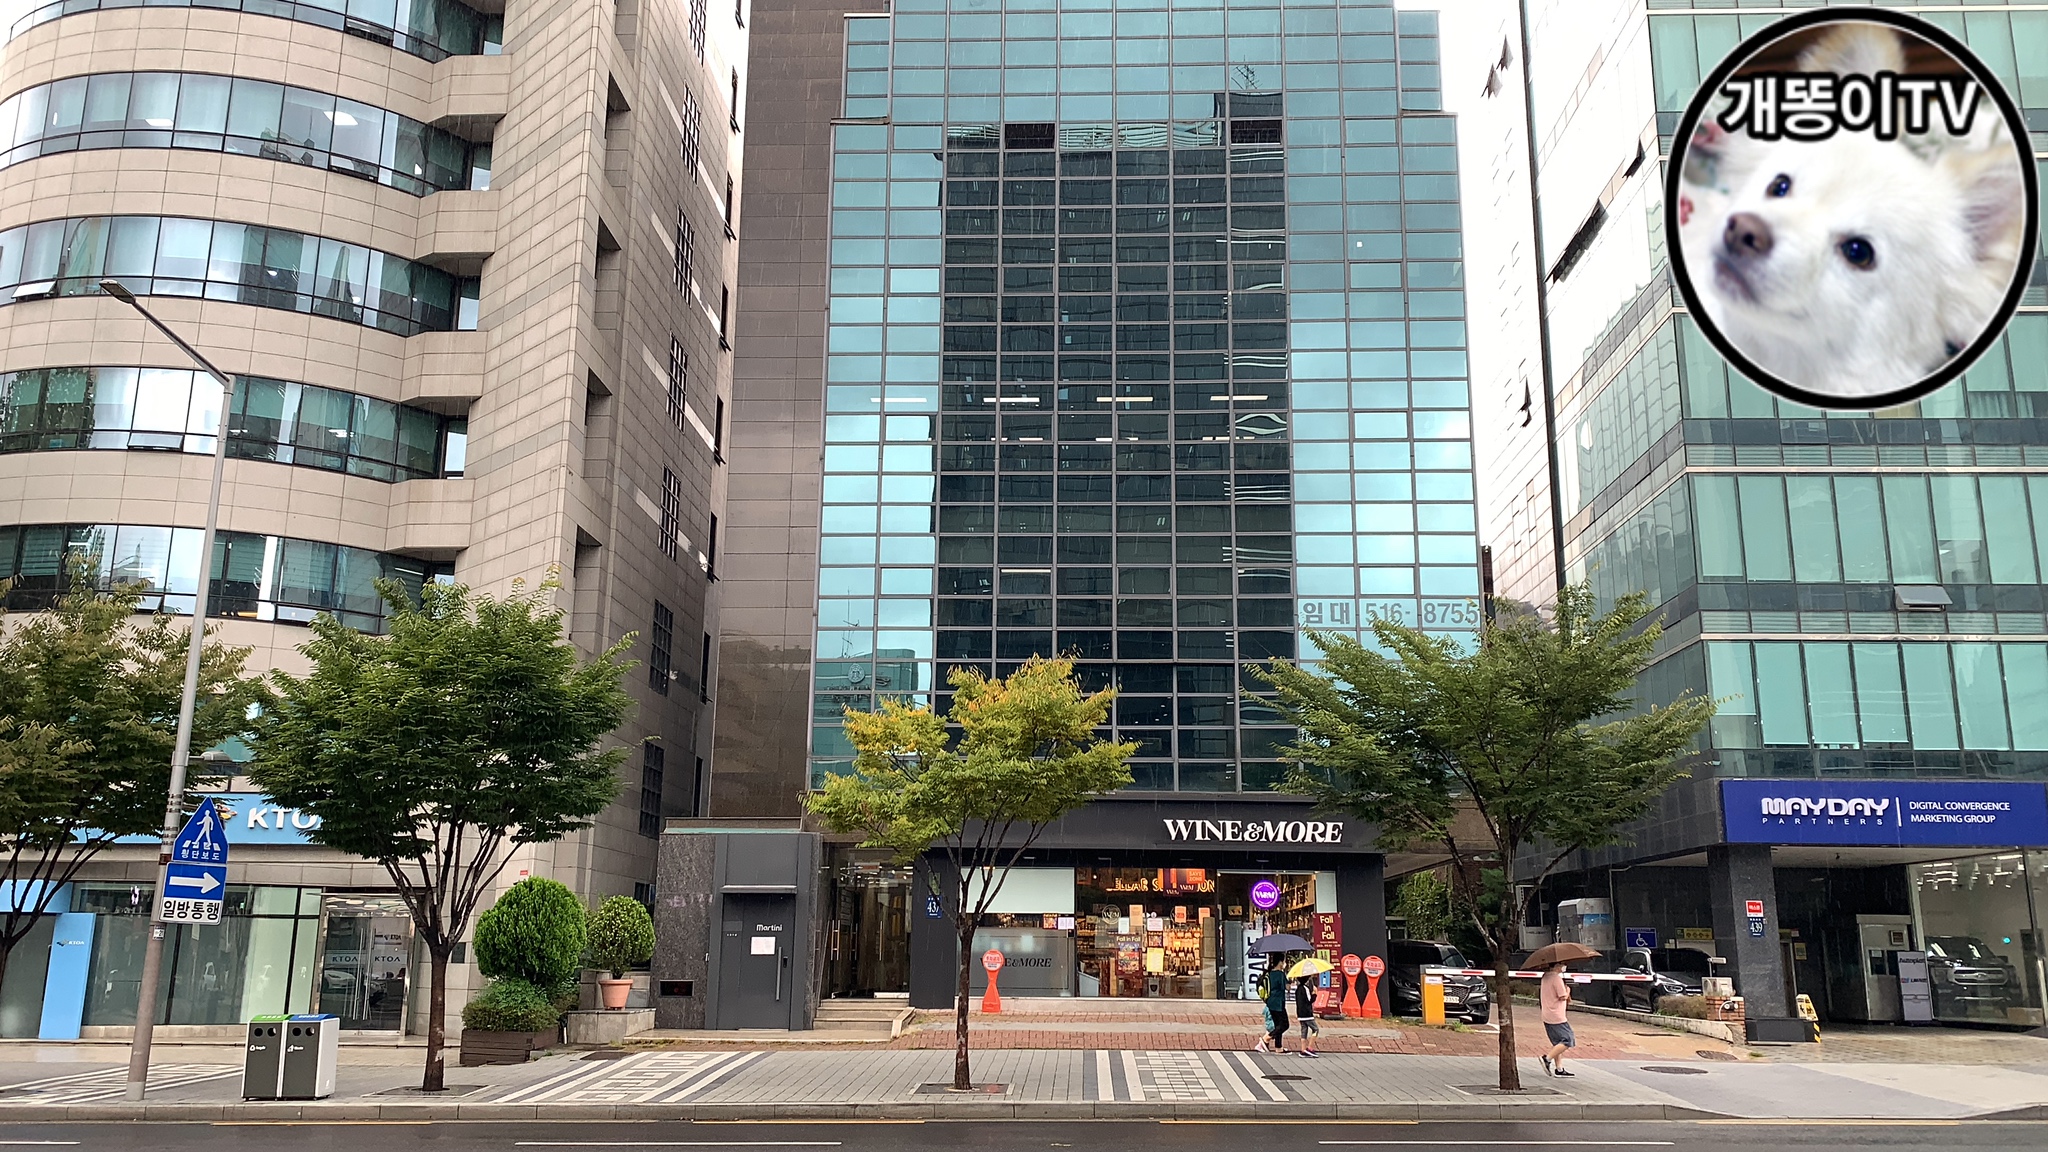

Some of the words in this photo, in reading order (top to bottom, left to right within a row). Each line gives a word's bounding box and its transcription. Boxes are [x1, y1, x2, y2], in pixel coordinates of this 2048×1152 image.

[1302, 602, 1351, 625] 임대
[1760, 796, 1890, 816] MAYDAY
[1908, 800, 1944, 811] DIGITAL
[1944, 801, 2011, 812] CONVERGENCE
[246, 806, 323, 830] KTO
[1761, 817, 1884, 826] PARTNERS
[1910, 814, 1962, 823] MARKETING
[1963, 814, 1996, 824] GROUP
[1162, 818, 1344, 844] WINE&MORE
[180, 849, 220, 861] 횡단보도
[162, 899, 221, 920] 일방통행
[1319, 915, 1334, 924] Fall
[756, 924, 783, 932] Martini
[1323, 923, 1332, 932] in
[1749, 921, 1763, 933] 439
[1321, 931, 1335, 940] Fall
[374, 955, 401, 963] KTOA
